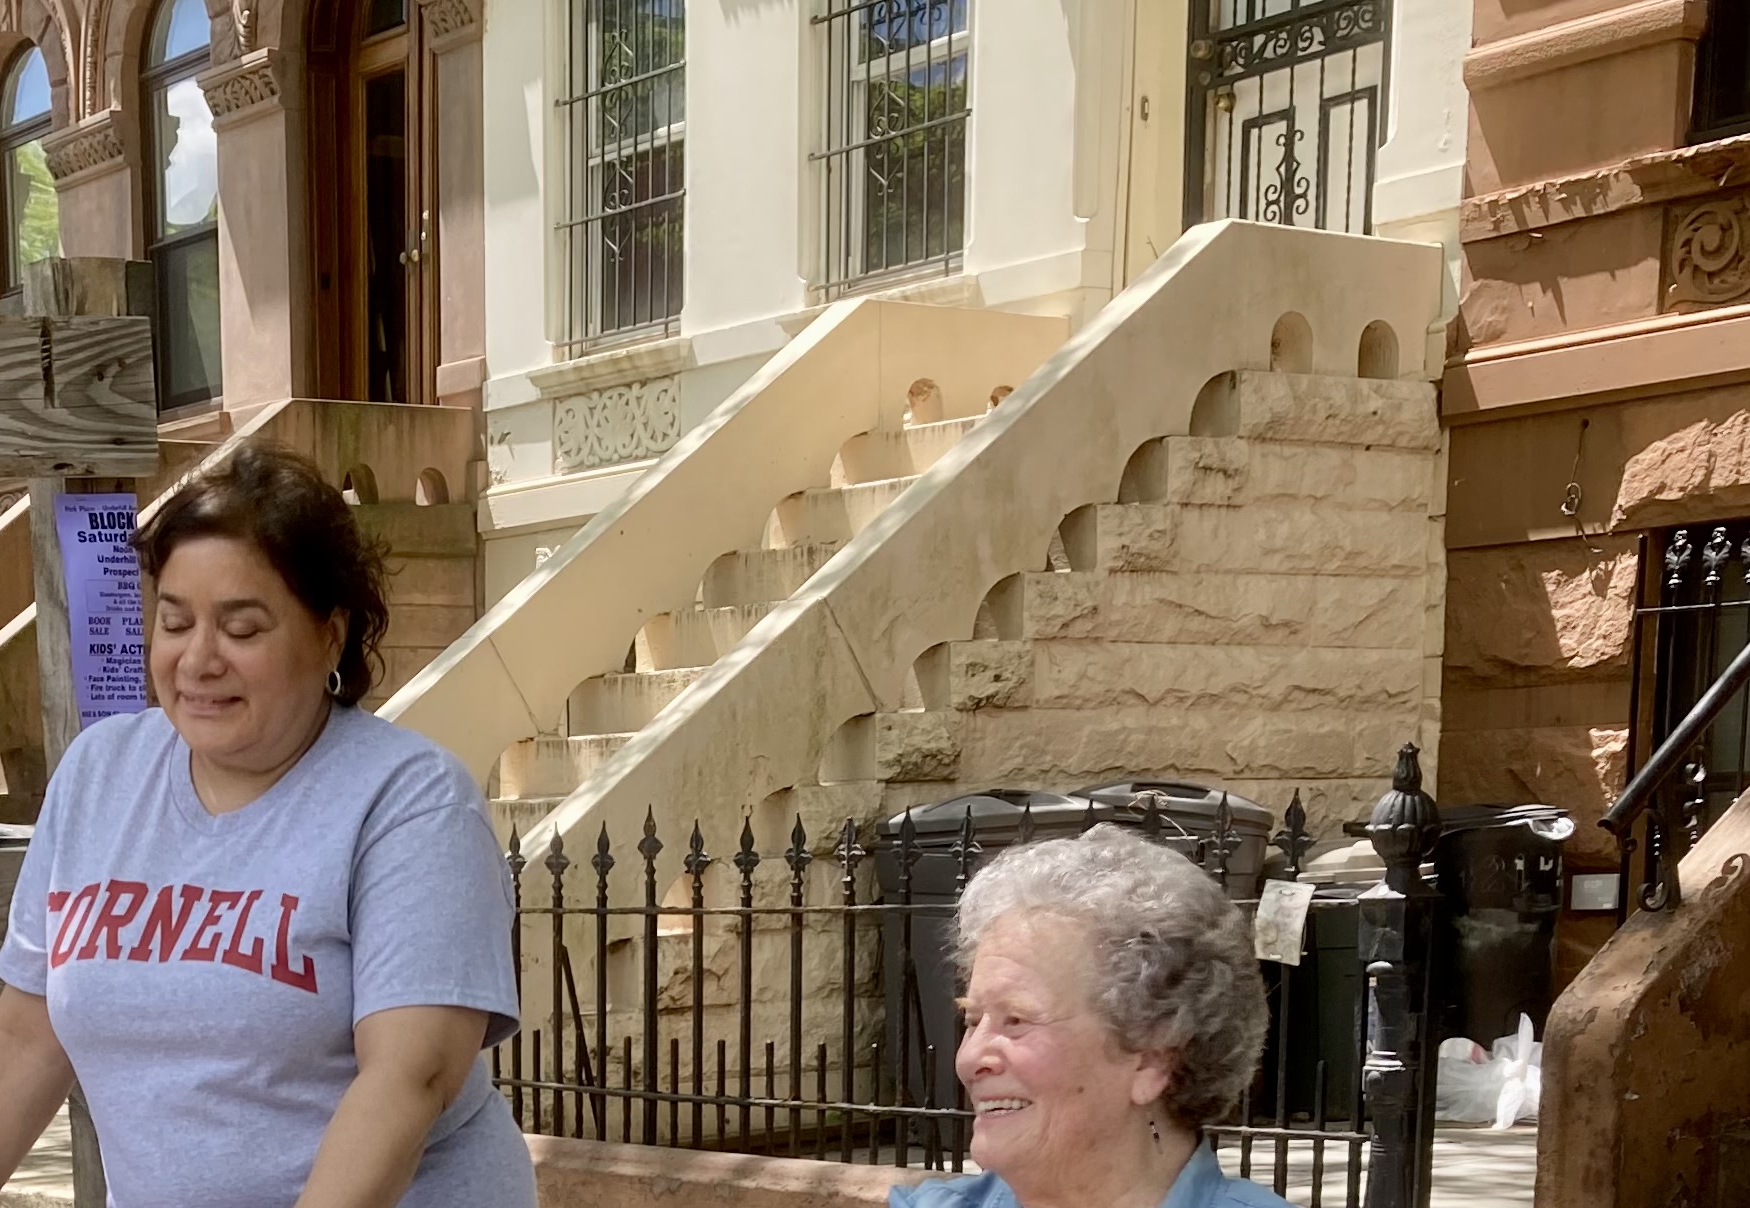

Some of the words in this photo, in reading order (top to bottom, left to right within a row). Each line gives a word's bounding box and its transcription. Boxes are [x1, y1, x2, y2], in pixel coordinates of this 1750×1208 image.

[88, 512, 134, 530] BLOCK
[97, 554, 136, 563] Underhill
[88, 617, 111, 625] BOOK
[90, 627, 109, 636] SALE
[90, 644, 116, 654] KIDS'
